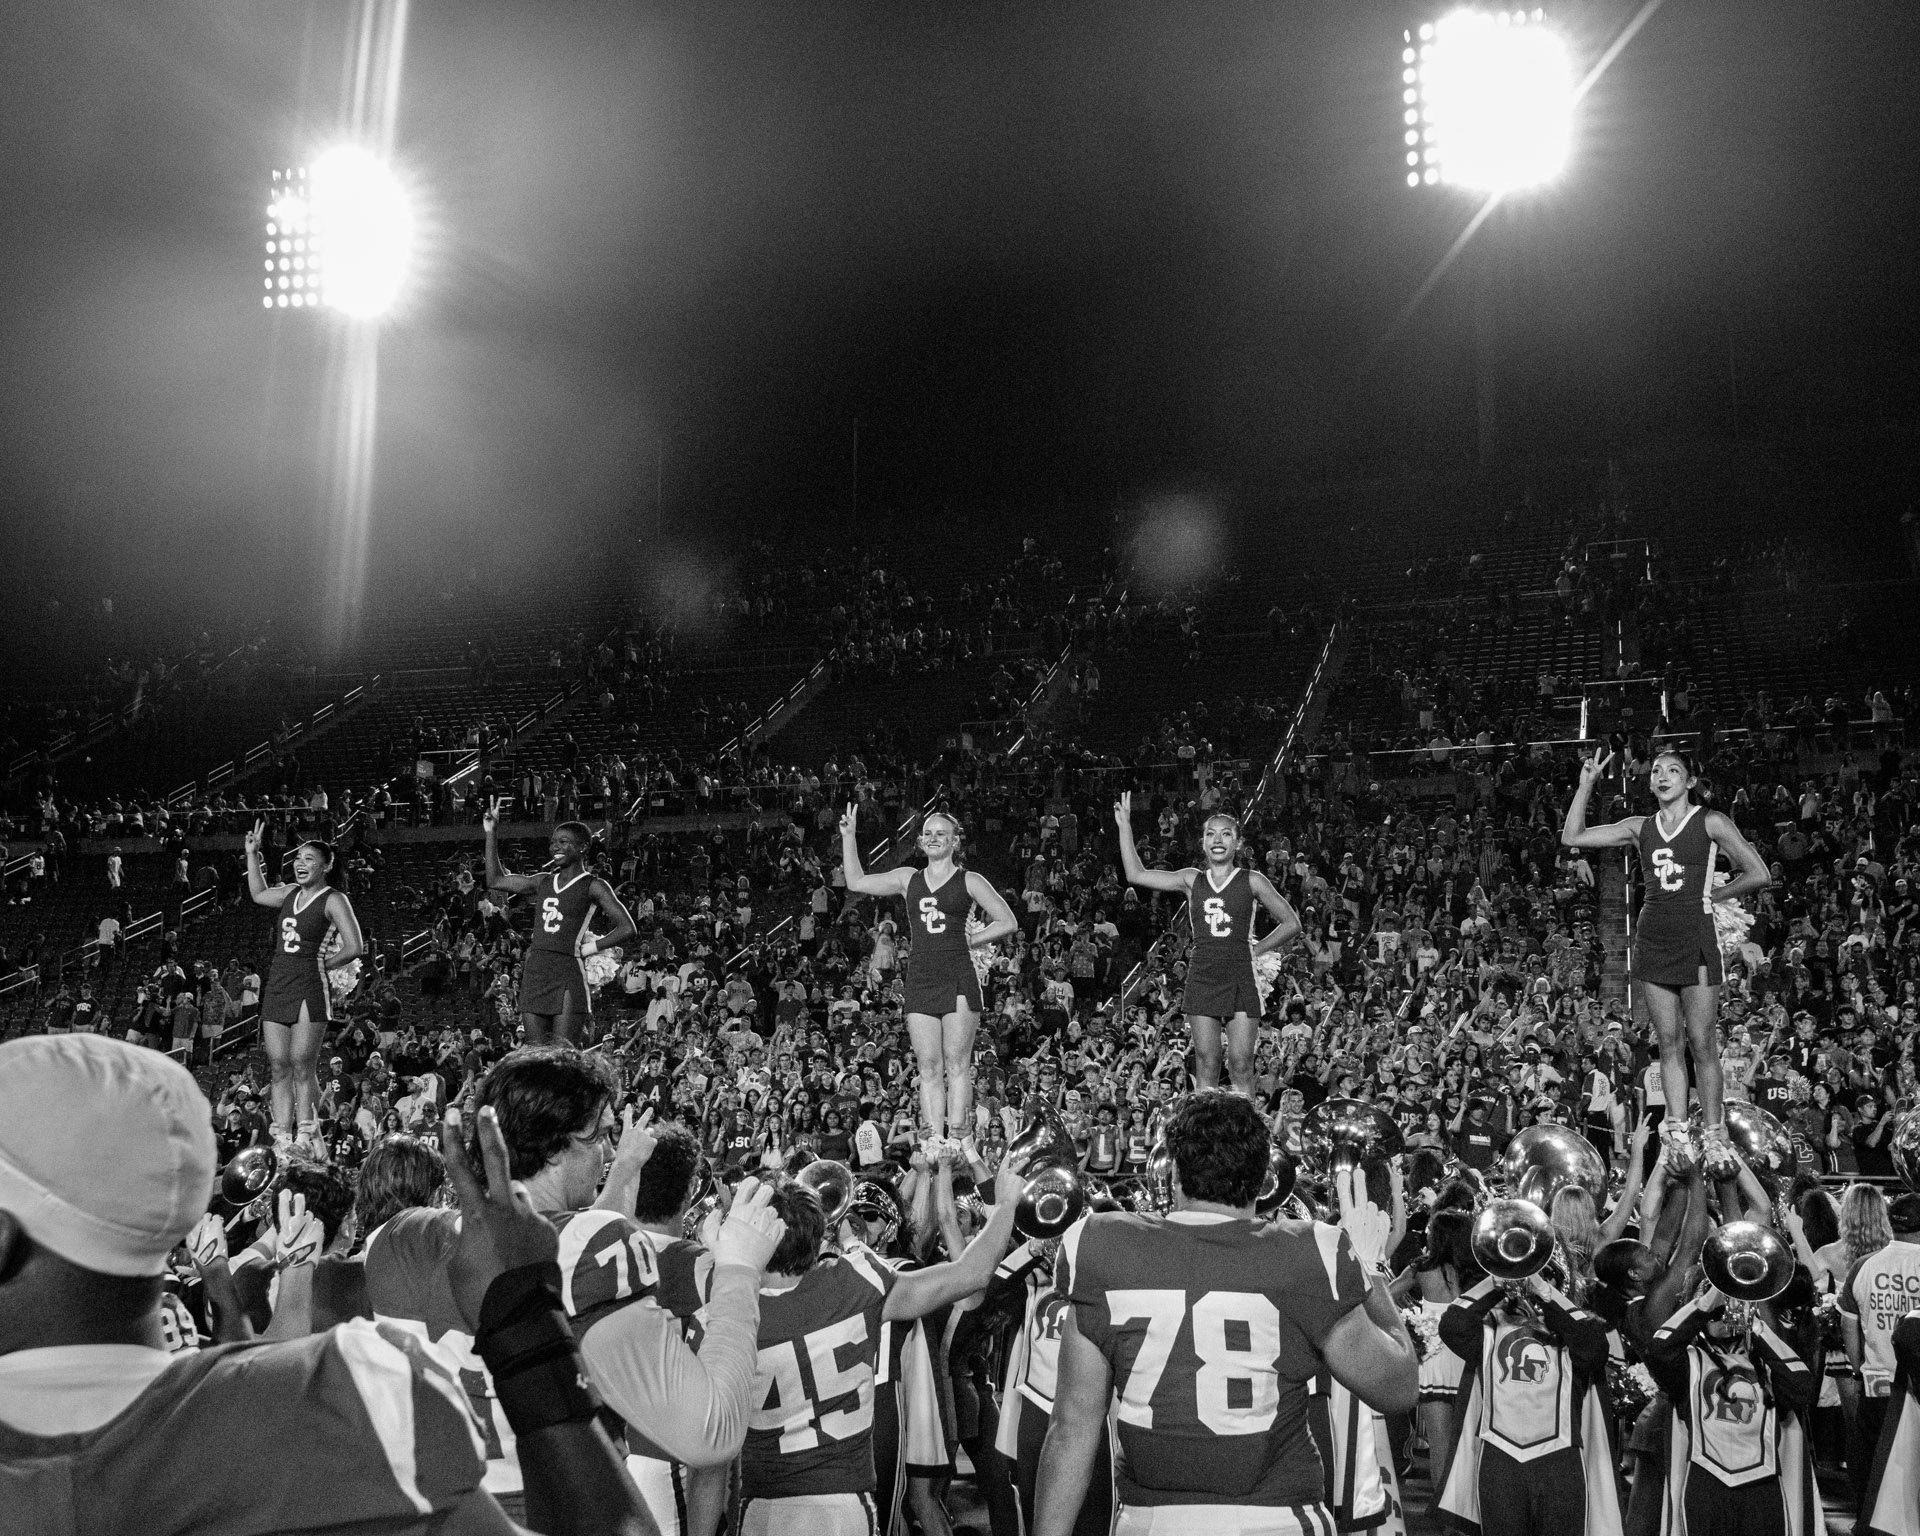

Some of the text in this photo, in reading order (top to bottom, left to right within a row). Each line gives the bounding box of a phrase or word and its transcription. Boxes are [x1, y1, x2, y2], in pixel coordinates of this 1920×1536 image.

[945, 738, 958, 748] 23
[1651, 847, 1685, 892] SC
[542, 897, 564, 934] SC
[919, 897, 947, 934] SC
[1203, 898, 1233, 938] SC
[282, 917, 301, 953] SC
[628, 967, 639, 978] 42
[76, 1002, 92, 1012] USC
[1801, 1047, 1809, 1067] 1
[331, 1079, 341, 1092] SC
[1649, 1072, 1661, 1080] CS
[649, 1085, 661, 1102] 4
[1767, 1087, 1792, 1101] US
[1400, 1112, 1423, 1125] USC
[726, 1136, 751, 1150] USC
[858, 1130, 873, 1138] CSC
[859, 1144, 874, 1152] STAFF
[1098, 1134, 1113, 1162] L
[1129, 1136, 1148, 1160] E
[594, 1229, 660, 1300] 70
[1874, 1273, 1920, 1293] CSC
[1876, 1312, 1900, 1331] STA
[1105, 1289, 1281, 1435] 78
[748, 1312, 875, 1455] 45
